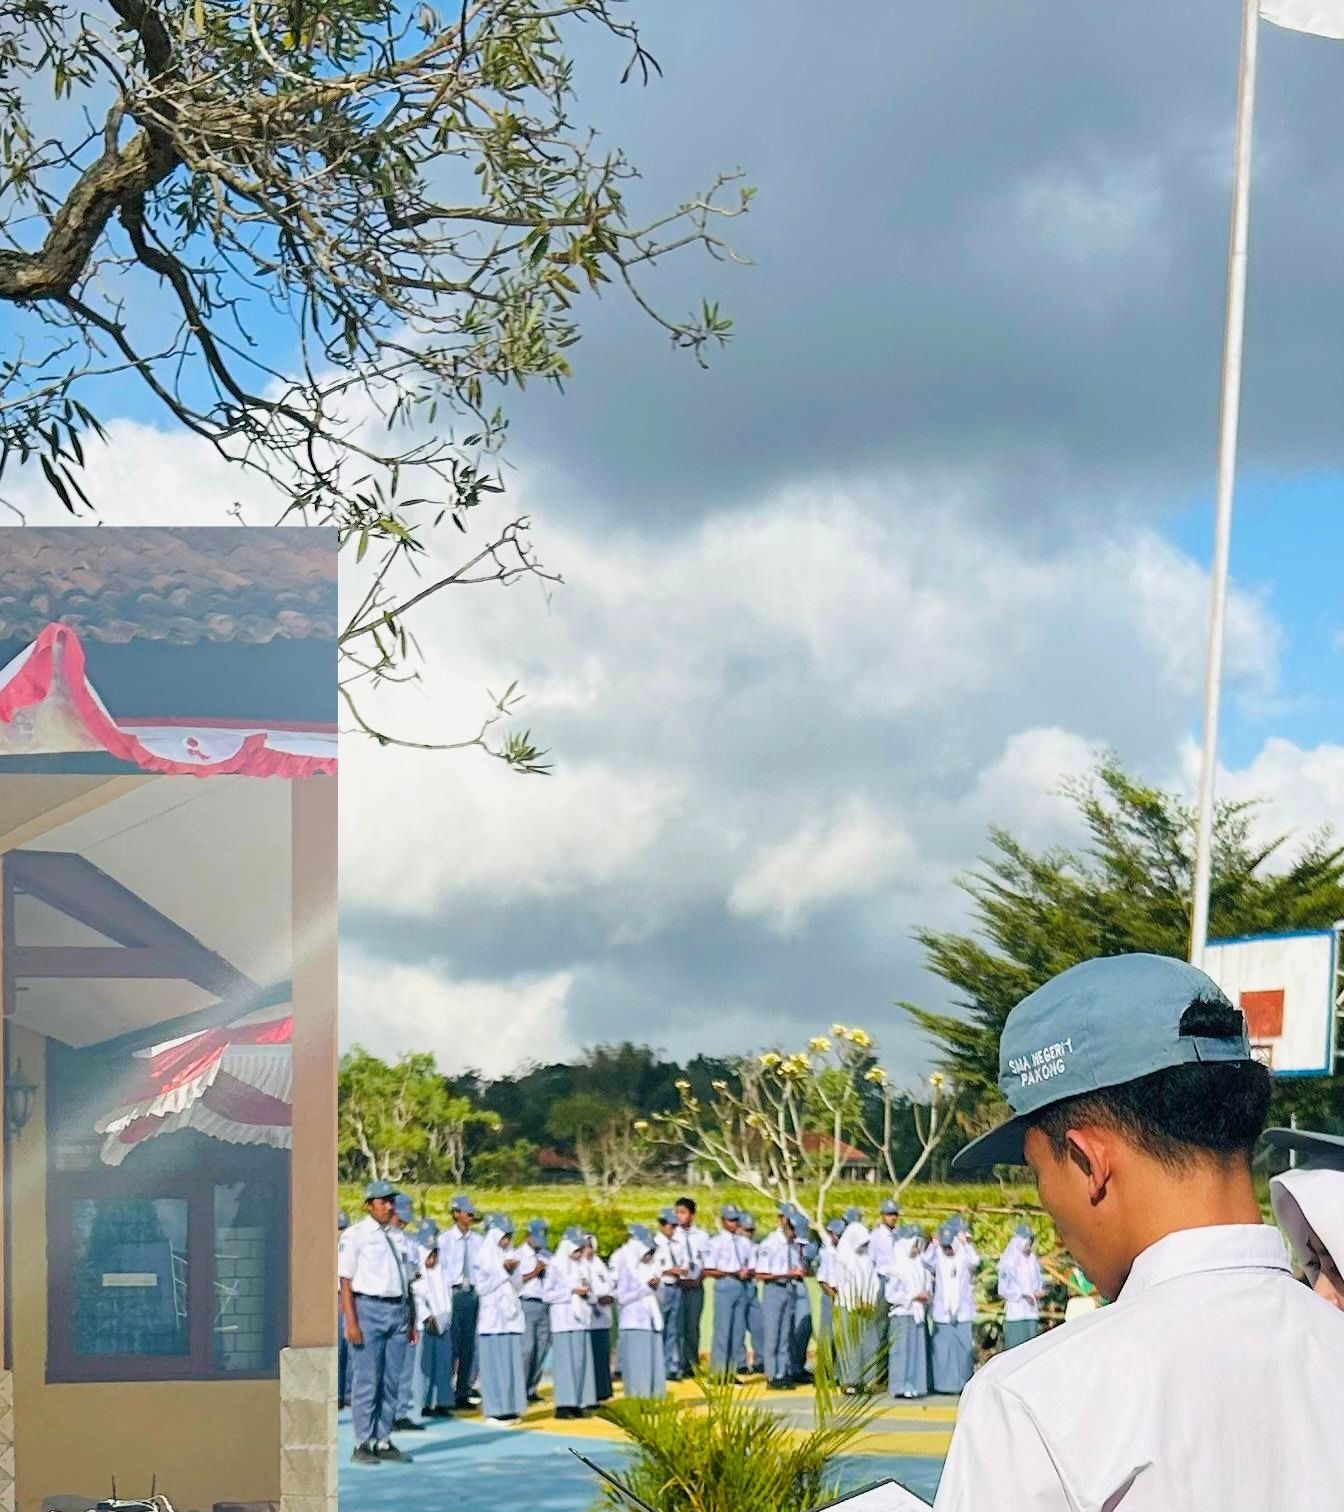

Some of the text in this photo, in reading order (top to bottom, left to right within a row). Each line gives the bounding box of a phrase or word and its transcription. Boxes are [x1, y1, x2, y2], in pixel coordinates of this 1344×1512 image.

[1008, 1055, 1031, 1074] SMA
[1031, 1042, 1066, 1068] NEGERI
[1020, 1058, 1066, 1088] PAKONG
